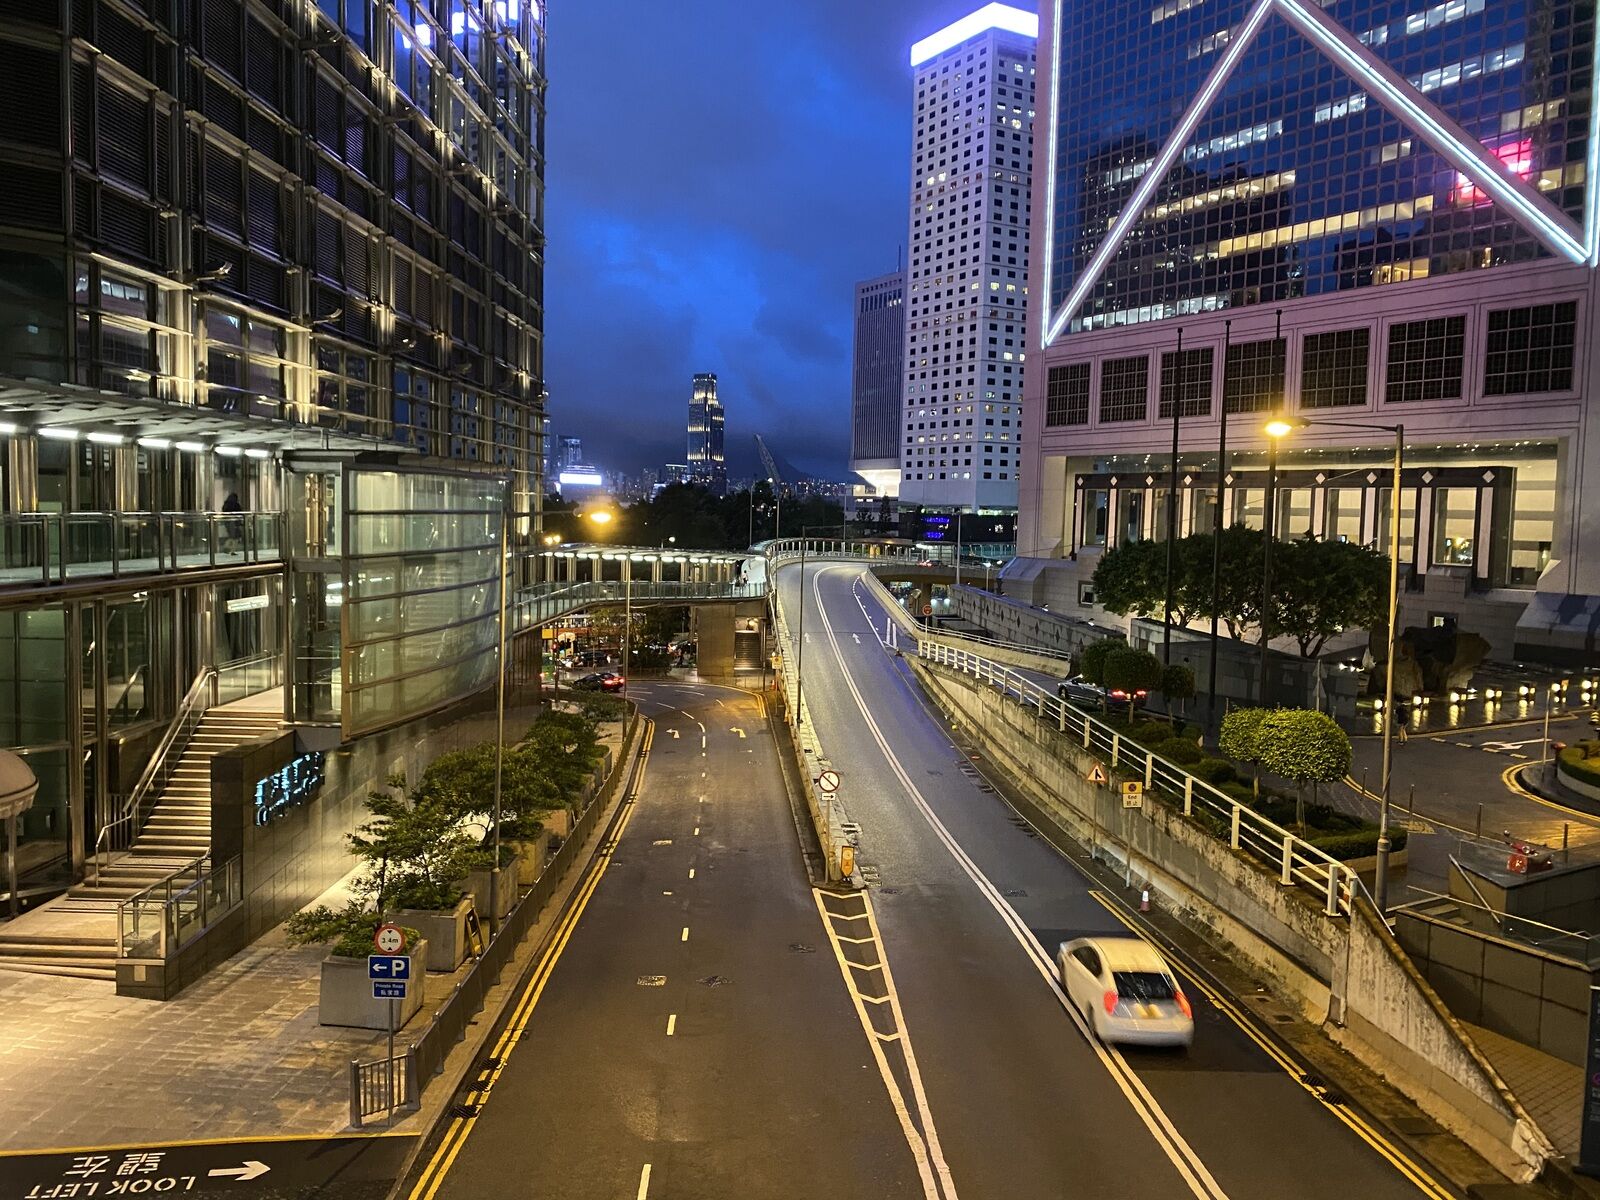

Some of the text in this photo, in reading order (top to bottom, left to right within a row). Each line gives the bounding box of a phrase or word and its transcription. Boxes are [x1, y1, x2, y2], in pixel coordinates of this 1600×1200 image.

[392, 960, 405, 976] P
[24, 1175, 196, 1199] LOOK LEFT
